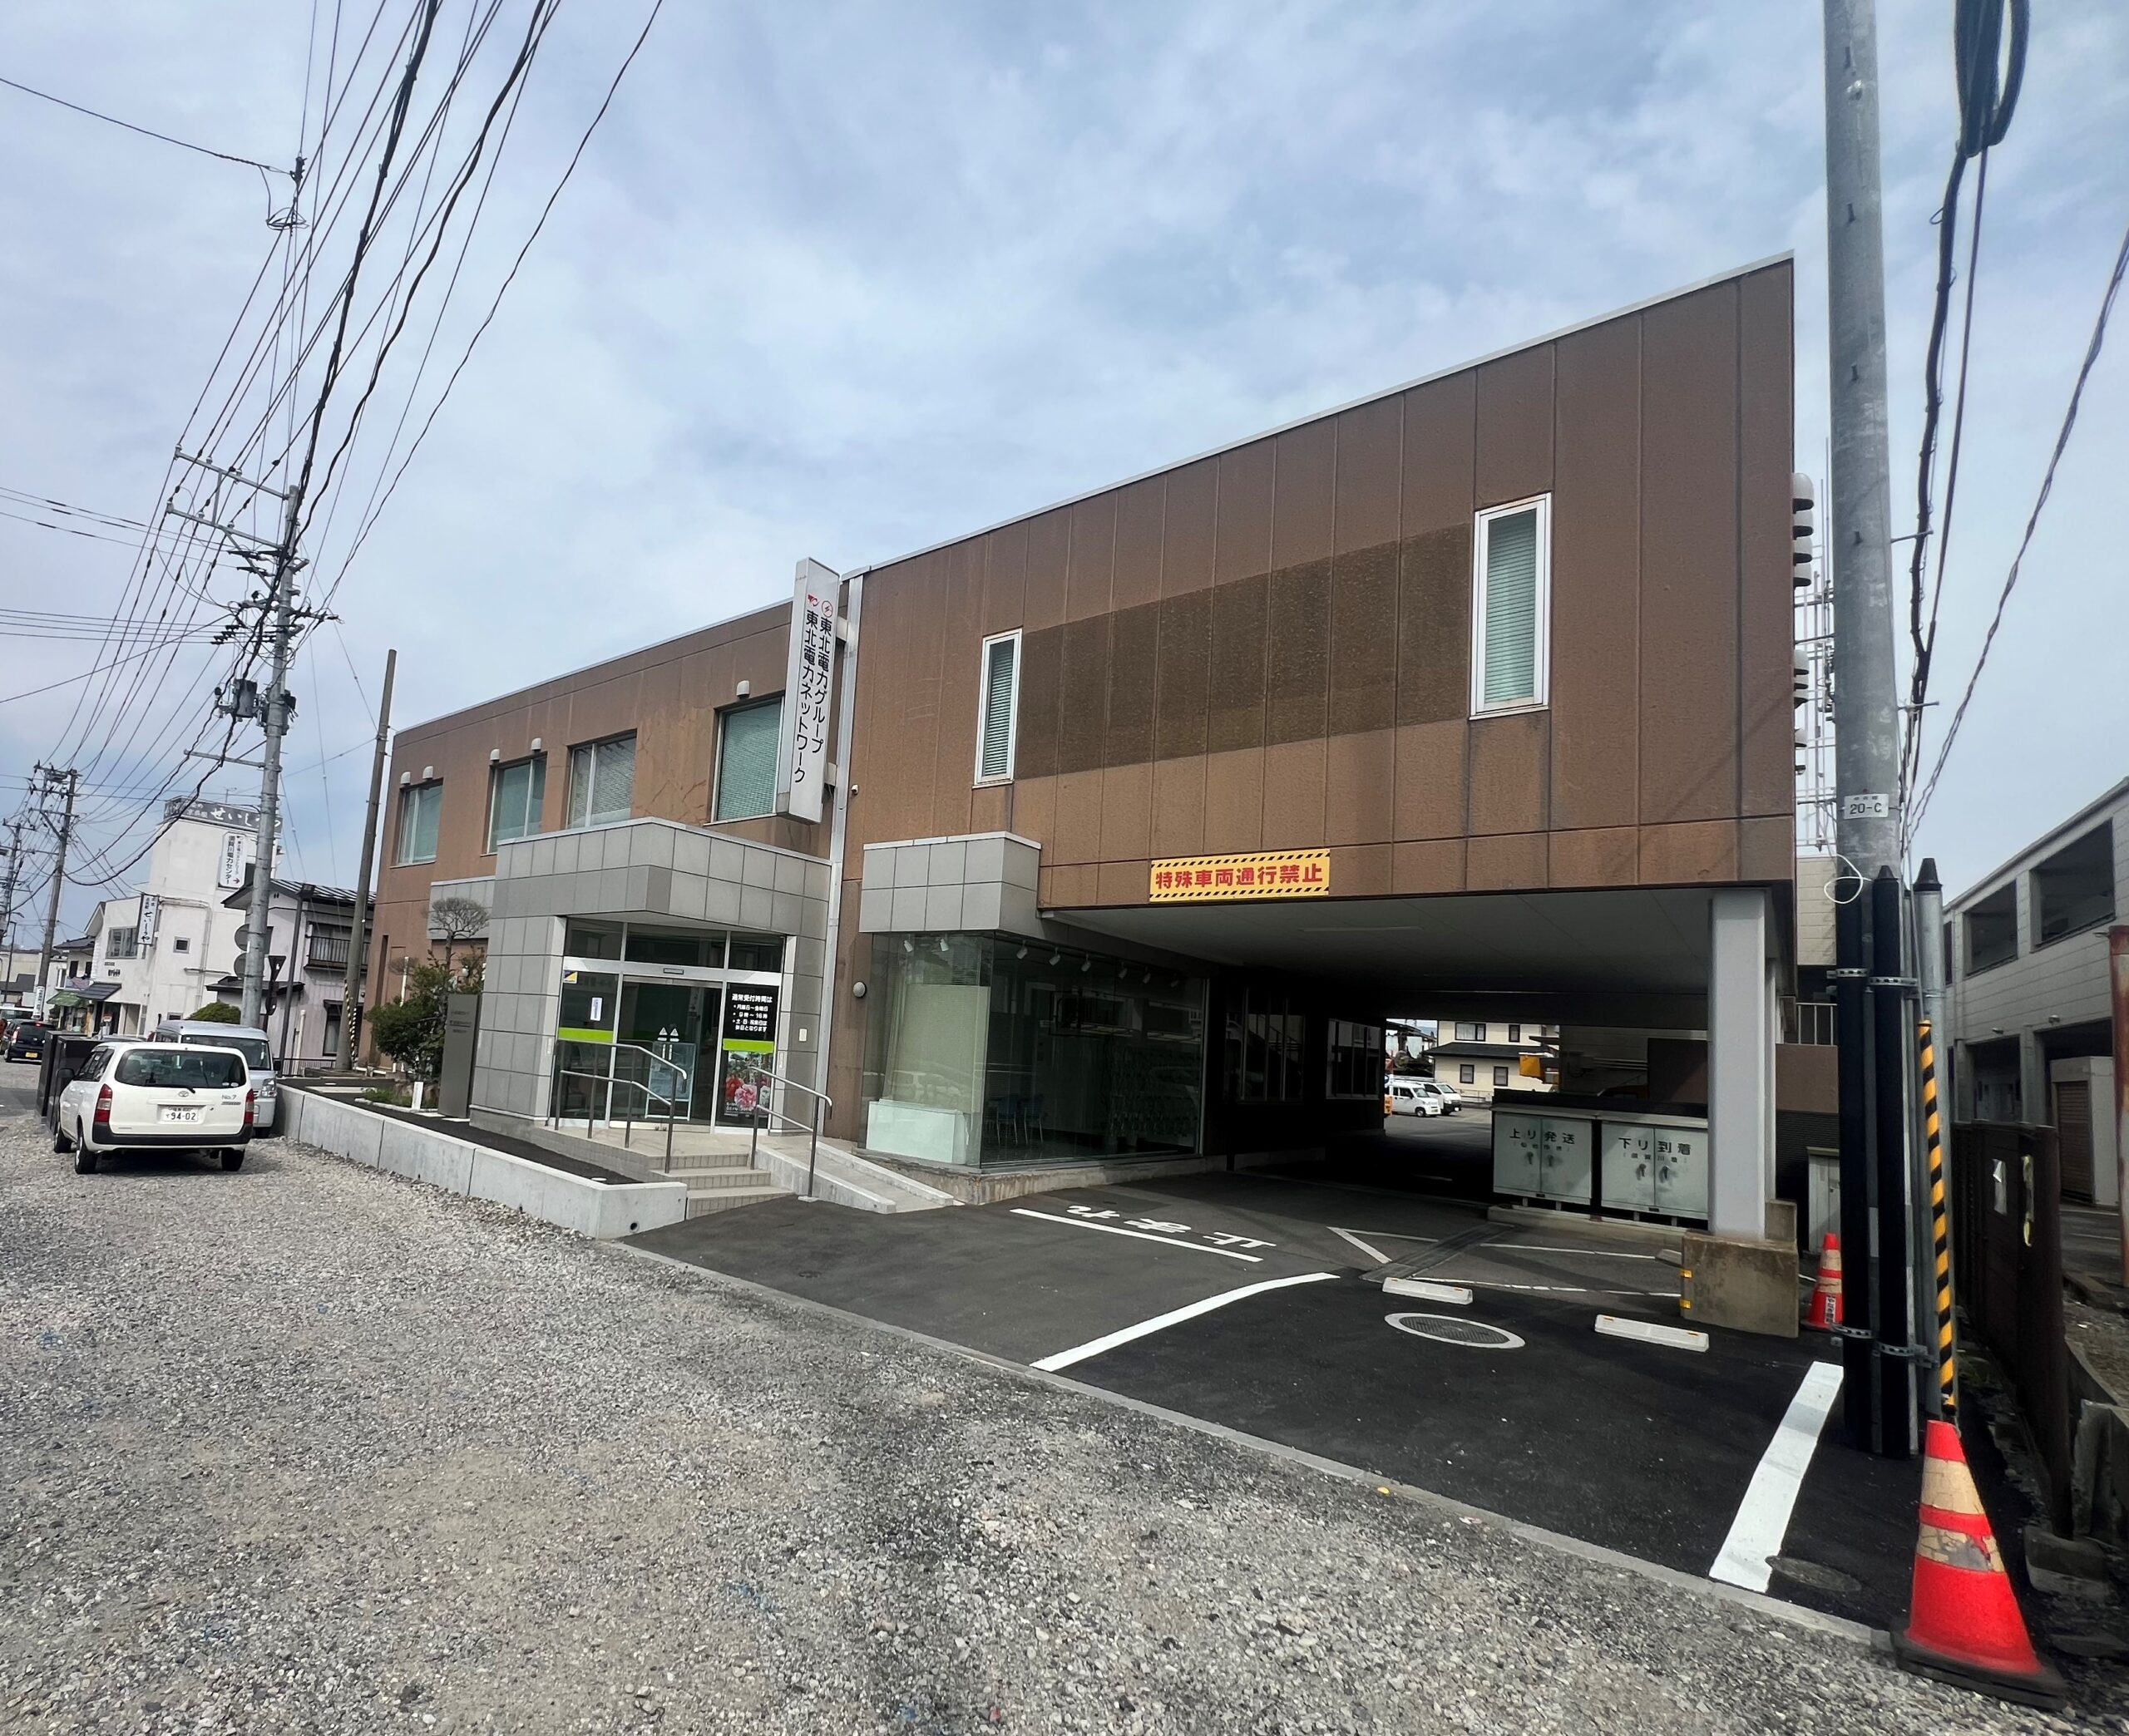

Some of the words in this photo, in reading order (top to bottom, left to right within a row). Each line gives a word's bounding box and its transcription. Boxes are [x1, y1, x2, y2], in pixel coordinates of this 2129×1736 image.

[812, 616, 832, 753] 東北電力グループ
[794, 609, 819, 783] 東北電力ネットワーク
[1850, 802, 1882, 814] 20-C
[1155, 863, 1323, 889] 特殊車両通行禁止
[170, 1112, 196, 1121] 94-02
[1509, 1128, 1575, 1145] 上り発送
[1618, 1137, 1692, 1156] 下り到着
[1066, 1206, 1277, 1248] 止まれ
